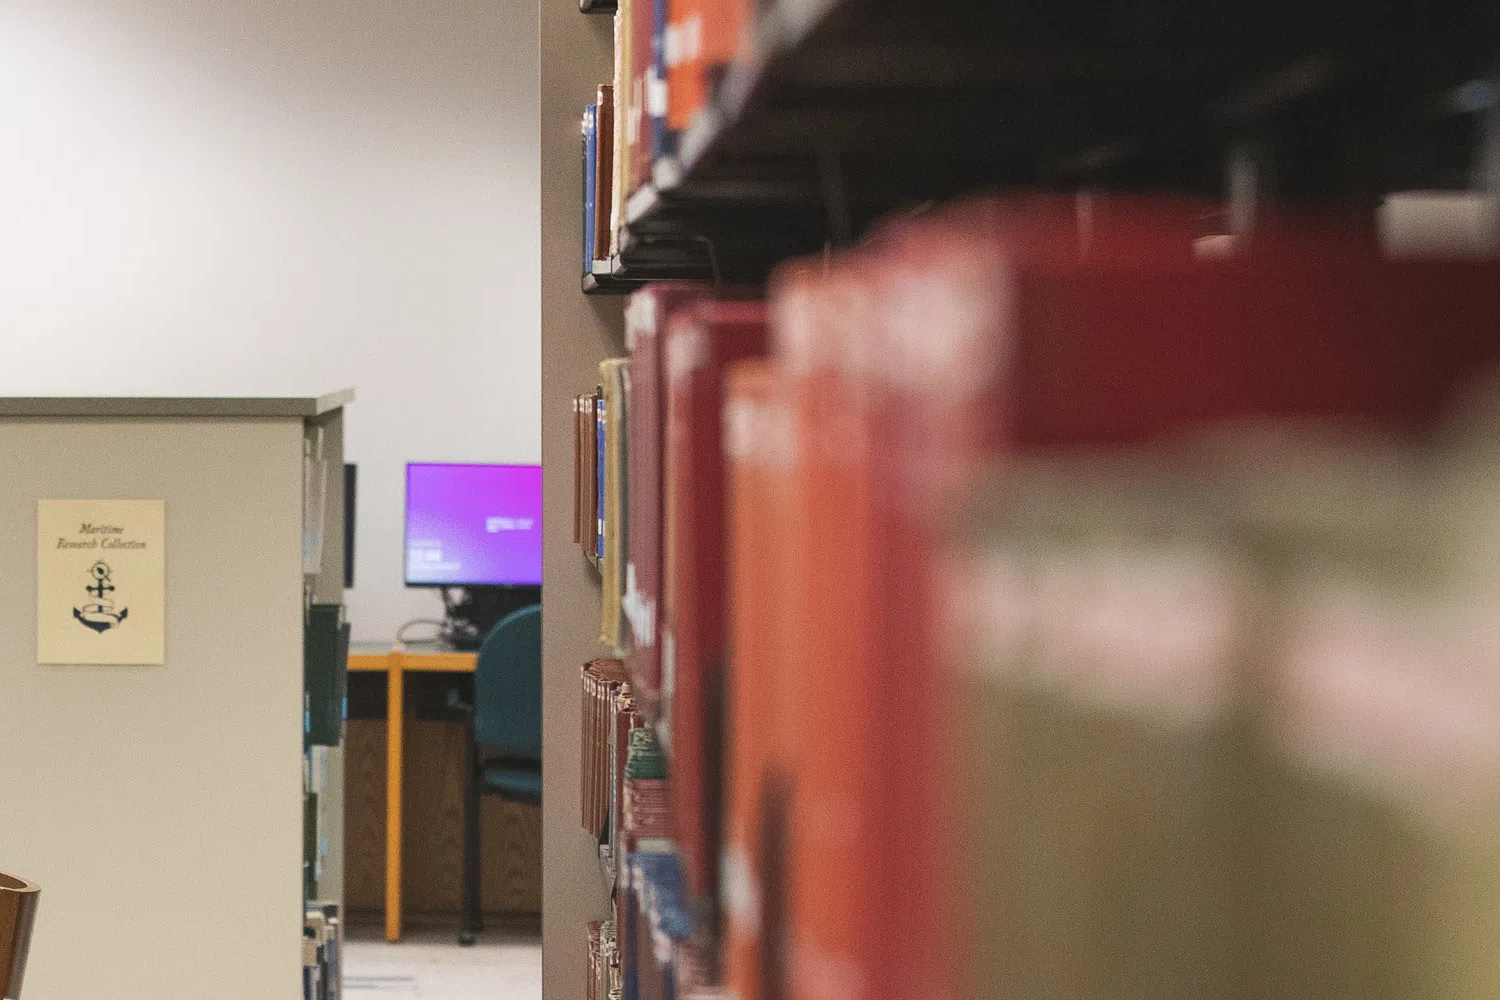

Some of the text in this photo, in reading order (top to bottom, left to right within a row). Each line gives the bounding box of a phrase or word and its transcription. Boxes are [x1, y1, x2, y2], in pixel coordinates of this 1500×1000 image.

[79, 523, 123, 534] Maritime
[56, 538, 146, 549] Research Collection
